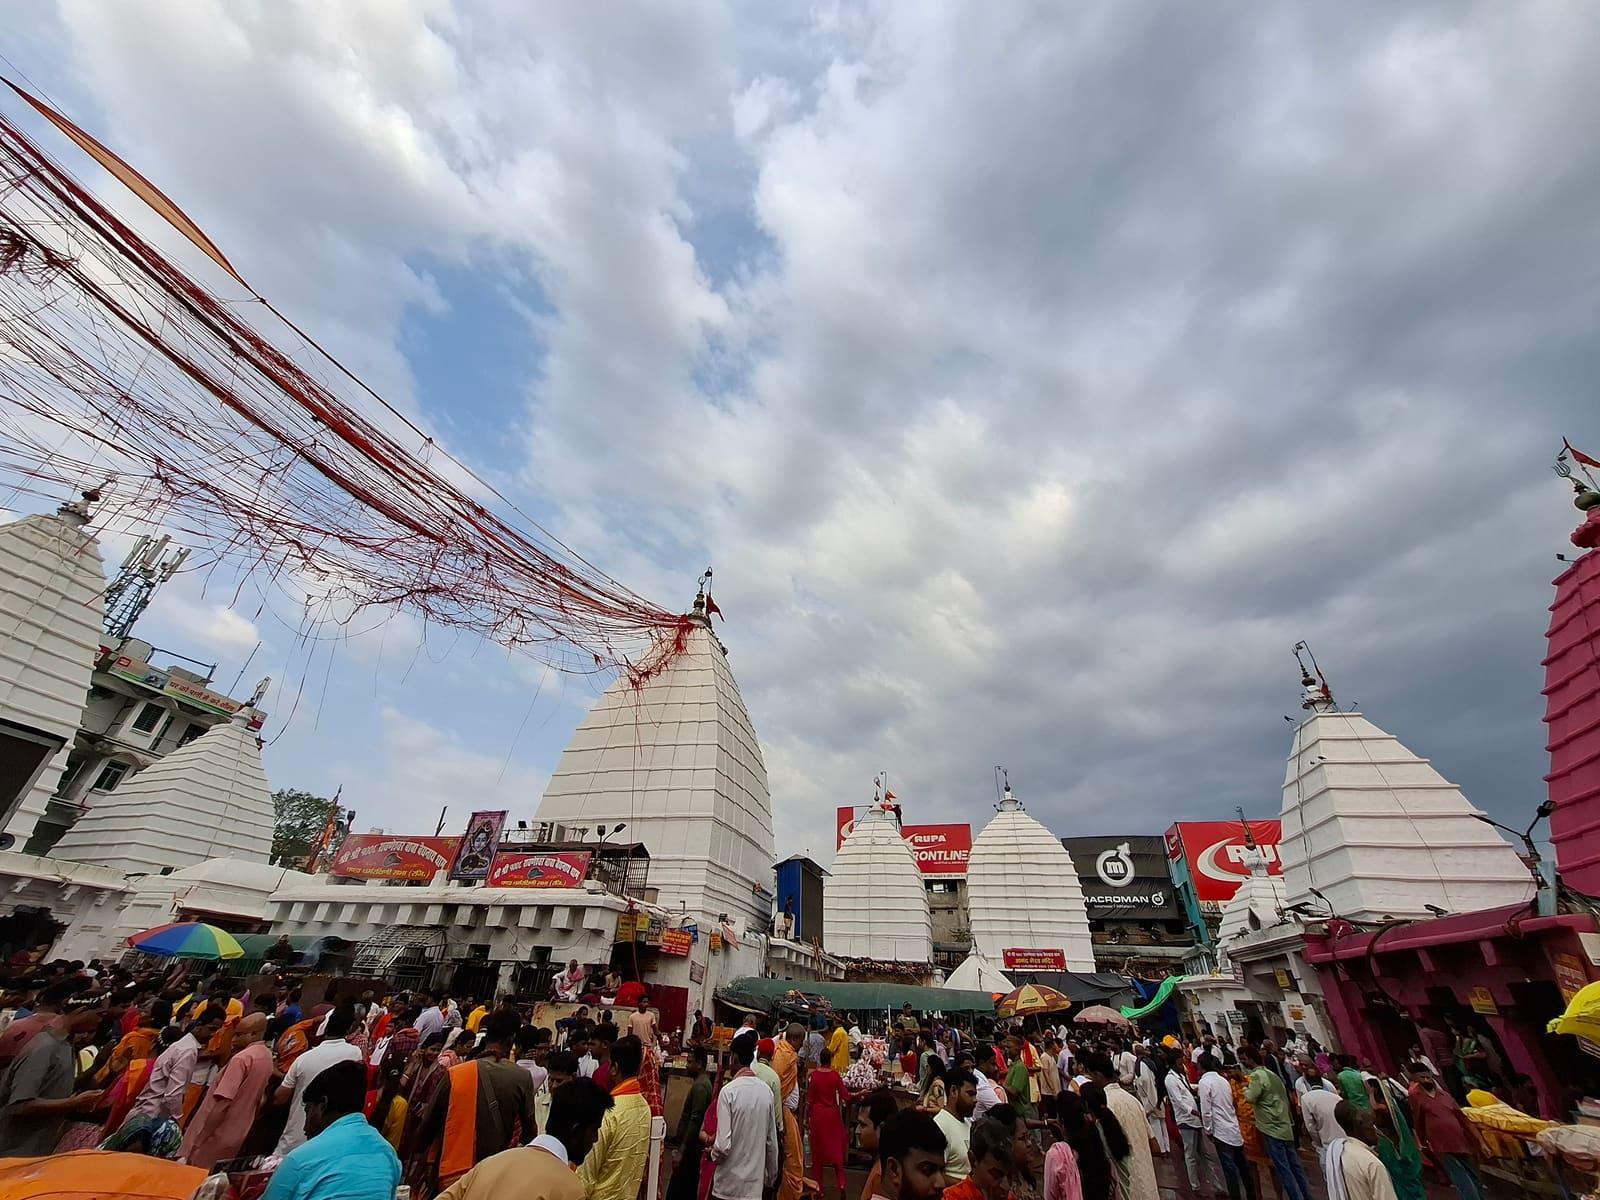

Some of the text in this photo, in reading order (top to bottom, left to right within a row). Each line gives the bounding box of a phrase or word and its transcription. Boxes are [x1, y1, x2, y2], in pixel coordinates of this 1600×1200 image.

[914, 834, 947, 843] RUPA
[338, 850, 352, 865] श्री
[351, 847, 361, 859] श्री
[913, 850, 969, 861] RONTLINE
[1226, 845, 1282, 863] RU
